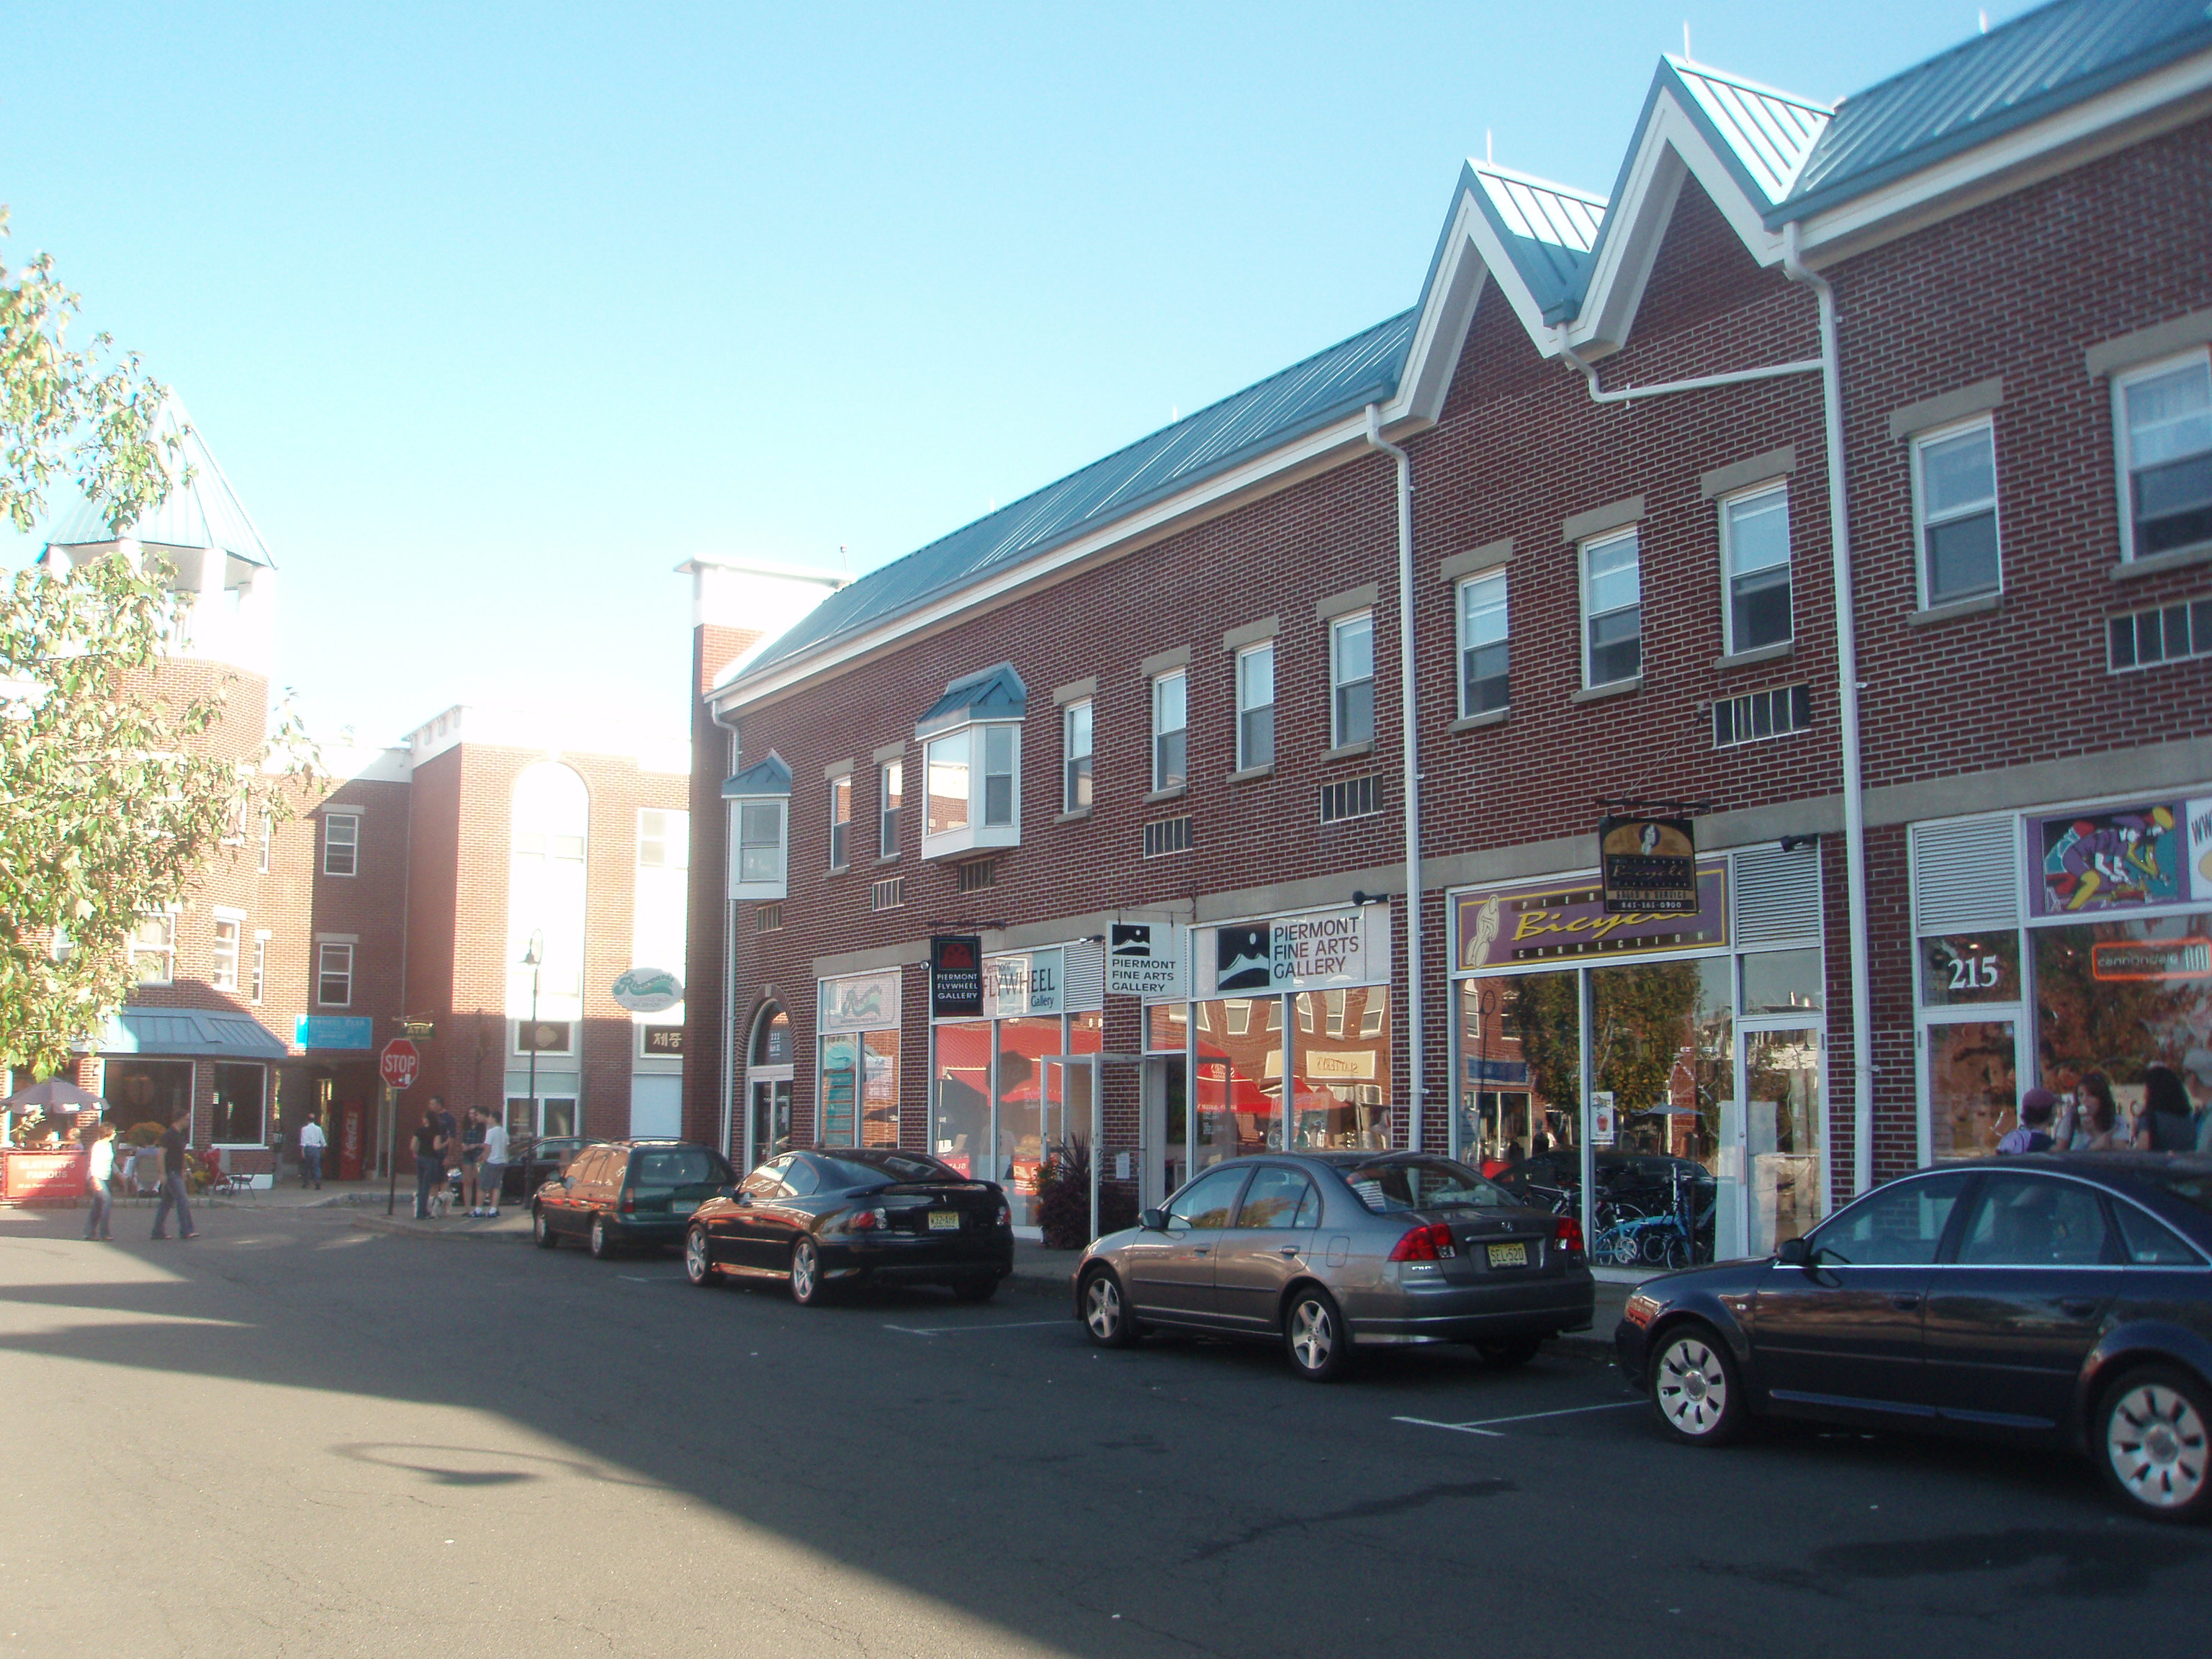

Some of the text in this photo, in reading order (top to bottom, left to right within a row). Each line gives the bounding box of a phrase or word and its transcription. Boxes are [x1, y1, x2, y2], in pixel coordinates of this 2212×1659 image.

[1655, 891, 1686, 900] SERVICE
[1274, 917, 1359, 943] PIERMONT
[1274, 936, 1359, 961] FINE ARTS
[1519, 932, 1704, 958] CONNECTION
[1112, 959, 1176, 969] PIERMONT
[2098, 953, 2178, 967] cannondale
[984, 961, 1012, 974] Piermont
[1274, 956, 1346, 979] GALLERY
[1948, 955, 1997, 989] 215
[983, 968, 1055, 998] FLYWHEEL
[1112, 971, 1174, 981] FINE ARTS
[1112, 982, 1165, 992] GALLERY
[1031, 995, 1054, 1008] Gallery
[385, 1054, 416, 1072] STOP
[26, 1170, 68, 1179] FAMOUS
